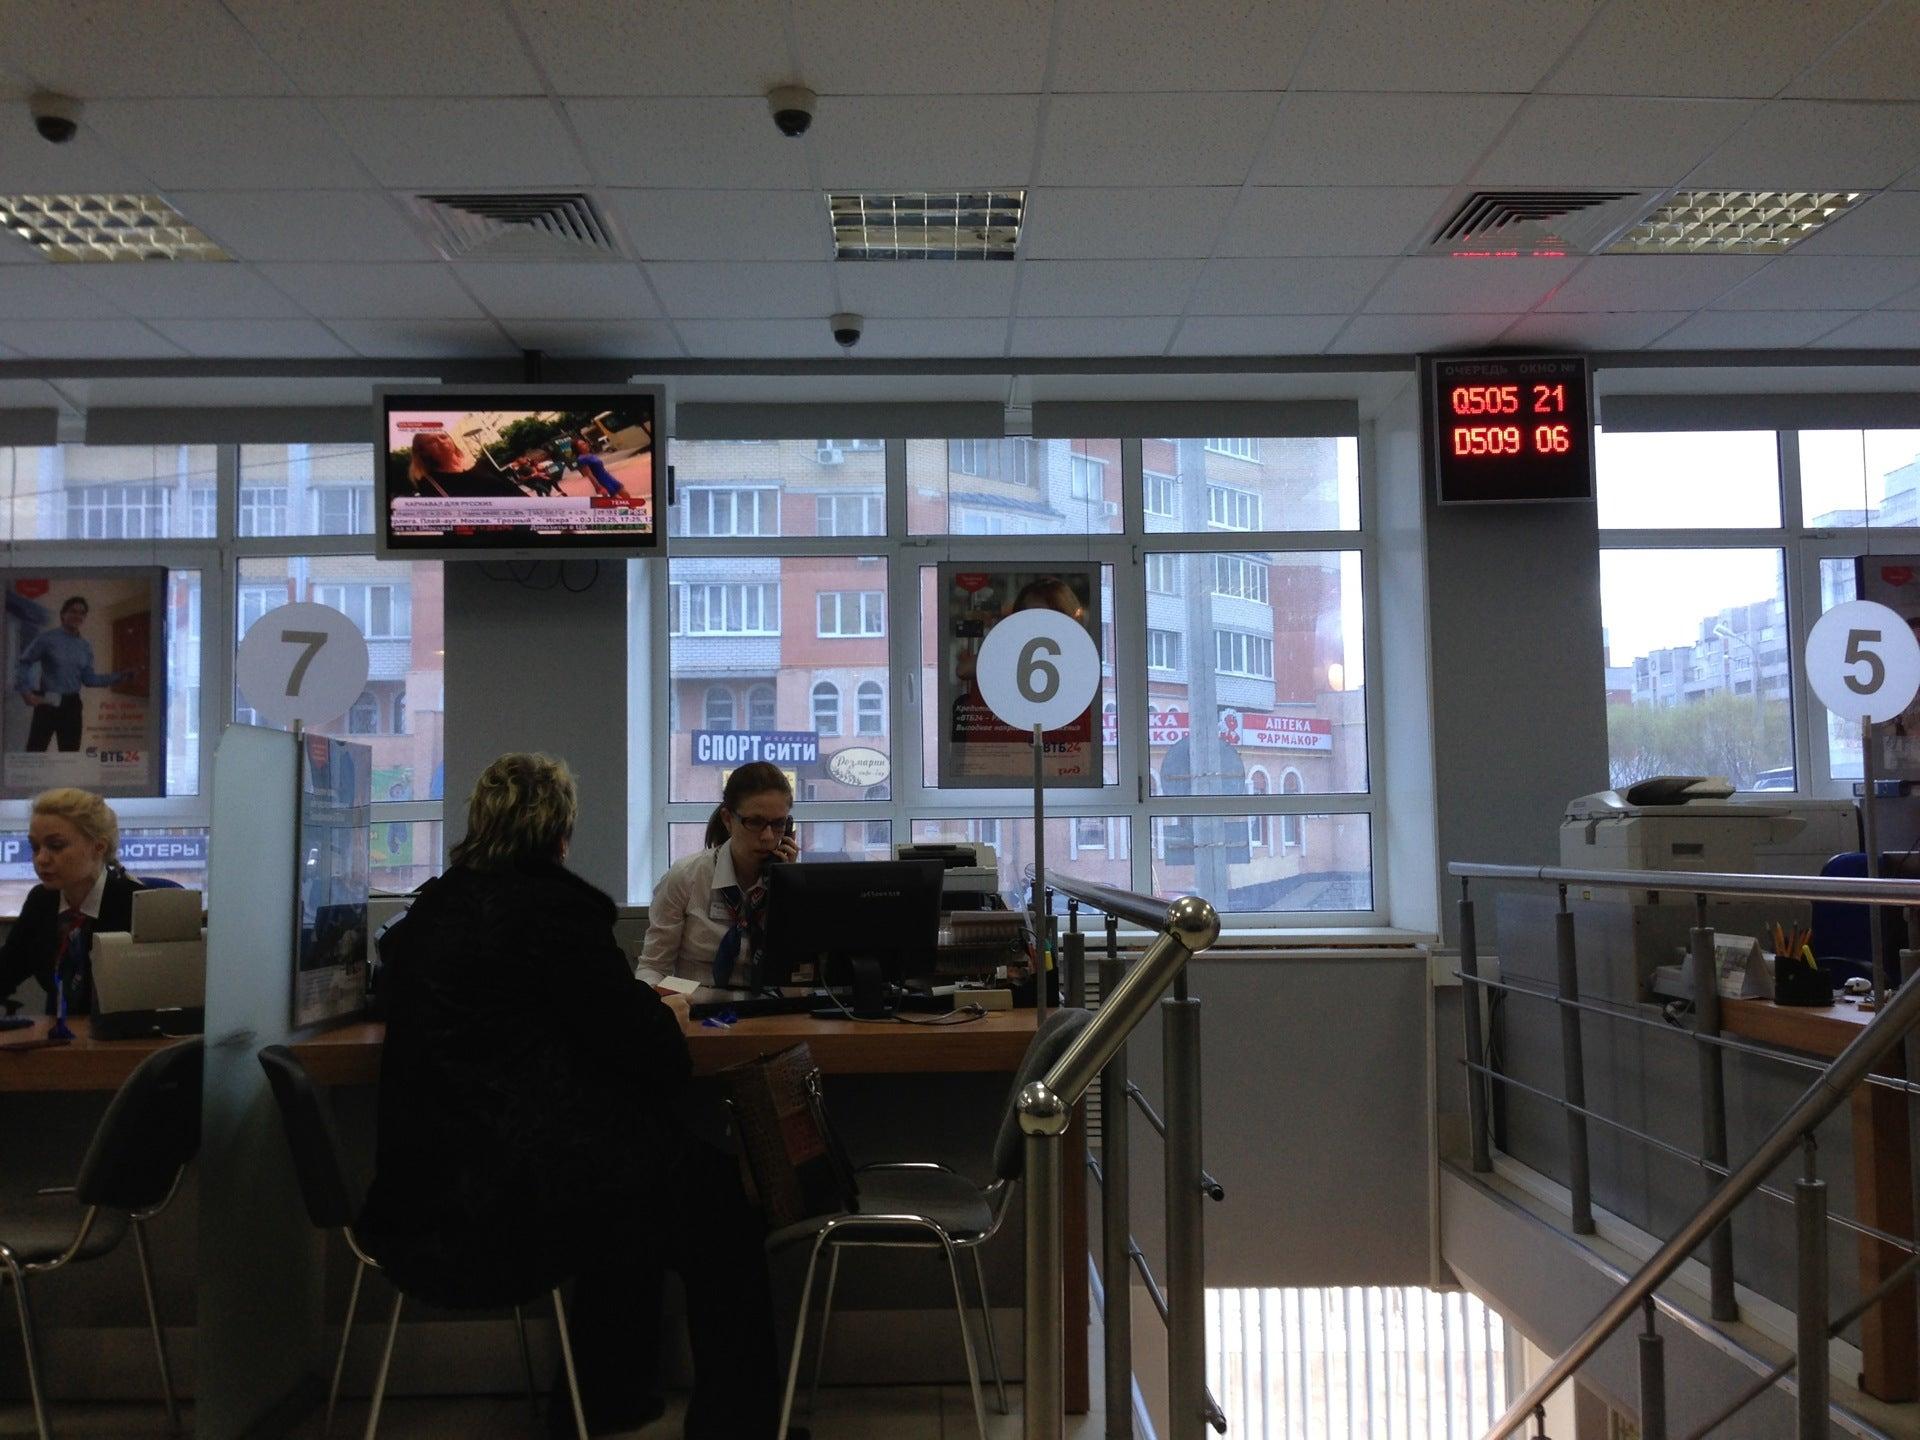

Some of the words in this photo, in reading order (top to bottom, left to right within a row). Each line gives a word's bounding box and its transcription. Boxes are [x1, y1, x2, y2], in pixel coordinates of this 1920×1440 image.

[1444, 365, 1509, 376] ОЧЕРЕДЬ
[1519, 362, 1557, 374] ОКНО
[1533, 385, 1564, 412] 21
[1454, 427, 1521, 455] D509
[1535, 426, 1569, 452] 06
[281, 630, 329, 696] 7
[1017, 637, 1061, 703] 6
[1843, 629, 1885, 695] 5
[1266, 718, 1312, 732] АПТЕКА
[698, 734, 762, 762] СПОРТ
[1257, 732, 1319, 746] ФАРМАКОР
[100, 751, 140, 762] ВТБ24
[837, 755, 886, 769] Розмарин
